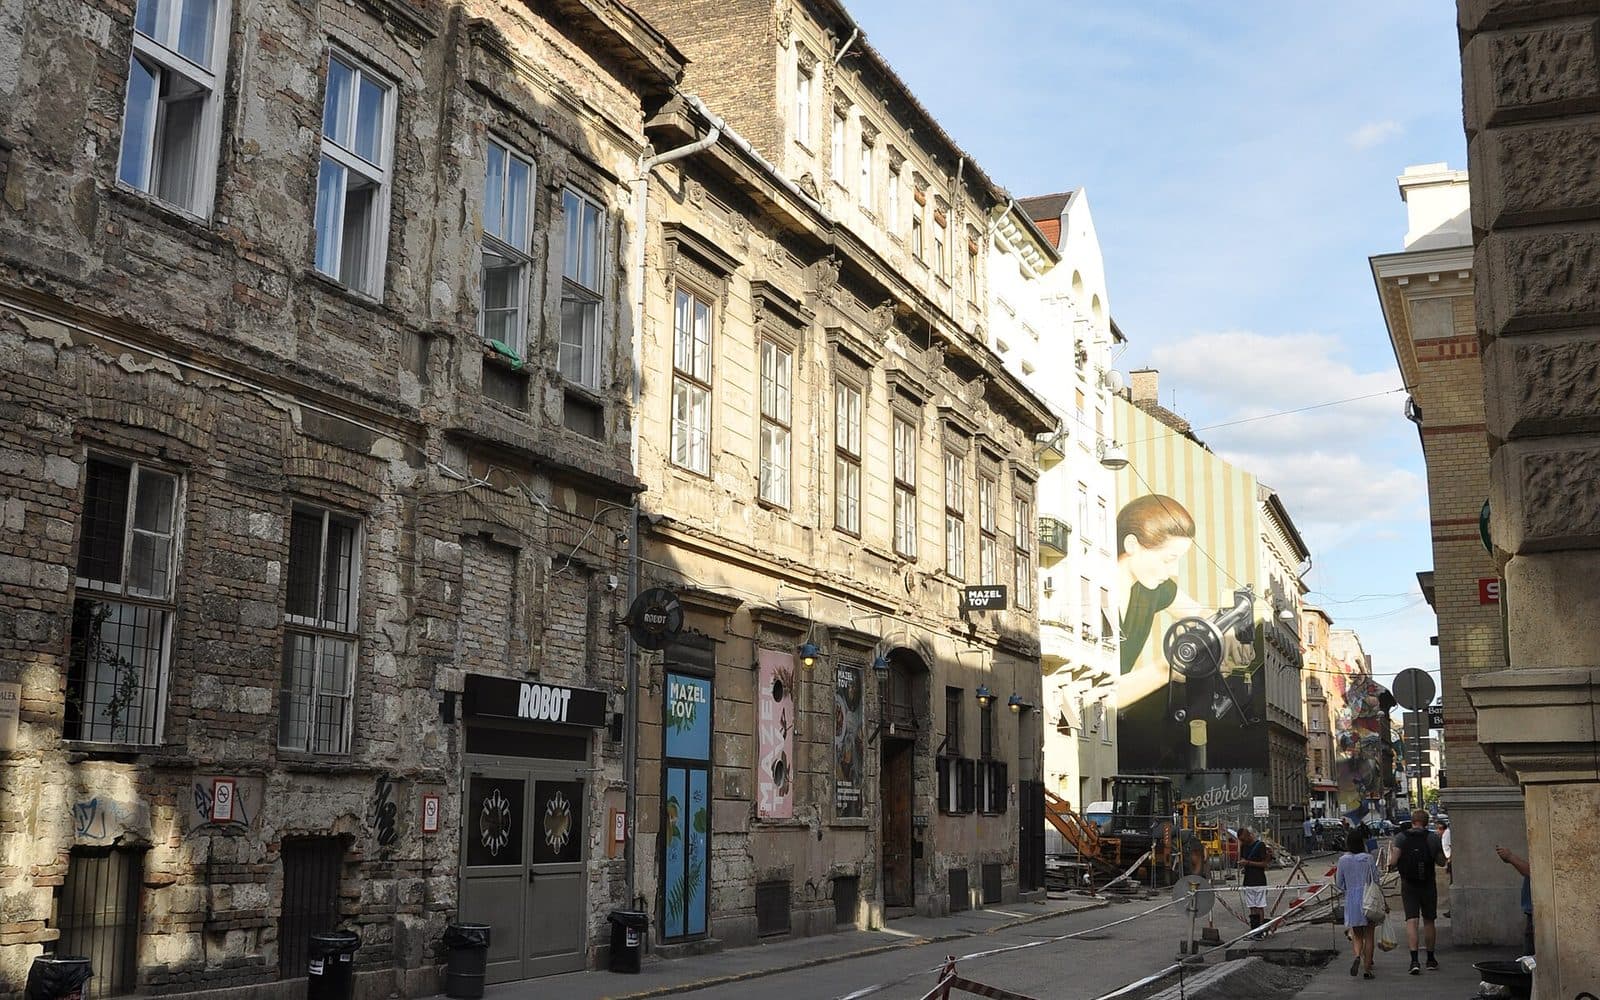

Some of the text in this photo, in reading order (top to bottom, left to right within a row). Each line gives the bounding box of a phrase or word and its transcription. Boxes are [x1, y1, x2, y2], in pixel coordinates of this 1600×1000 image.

[968, 590, 1002, 598] MAZEL
[969, 598, 989, 606] TOV
[670, 682, 706, 703] MAZEL
[838, 679, 849, 688] TOV
[518, 683, 571, 722] ROBOT
[671, 701, 694, 719] TOV
[773, 727, 785, 811] TV
